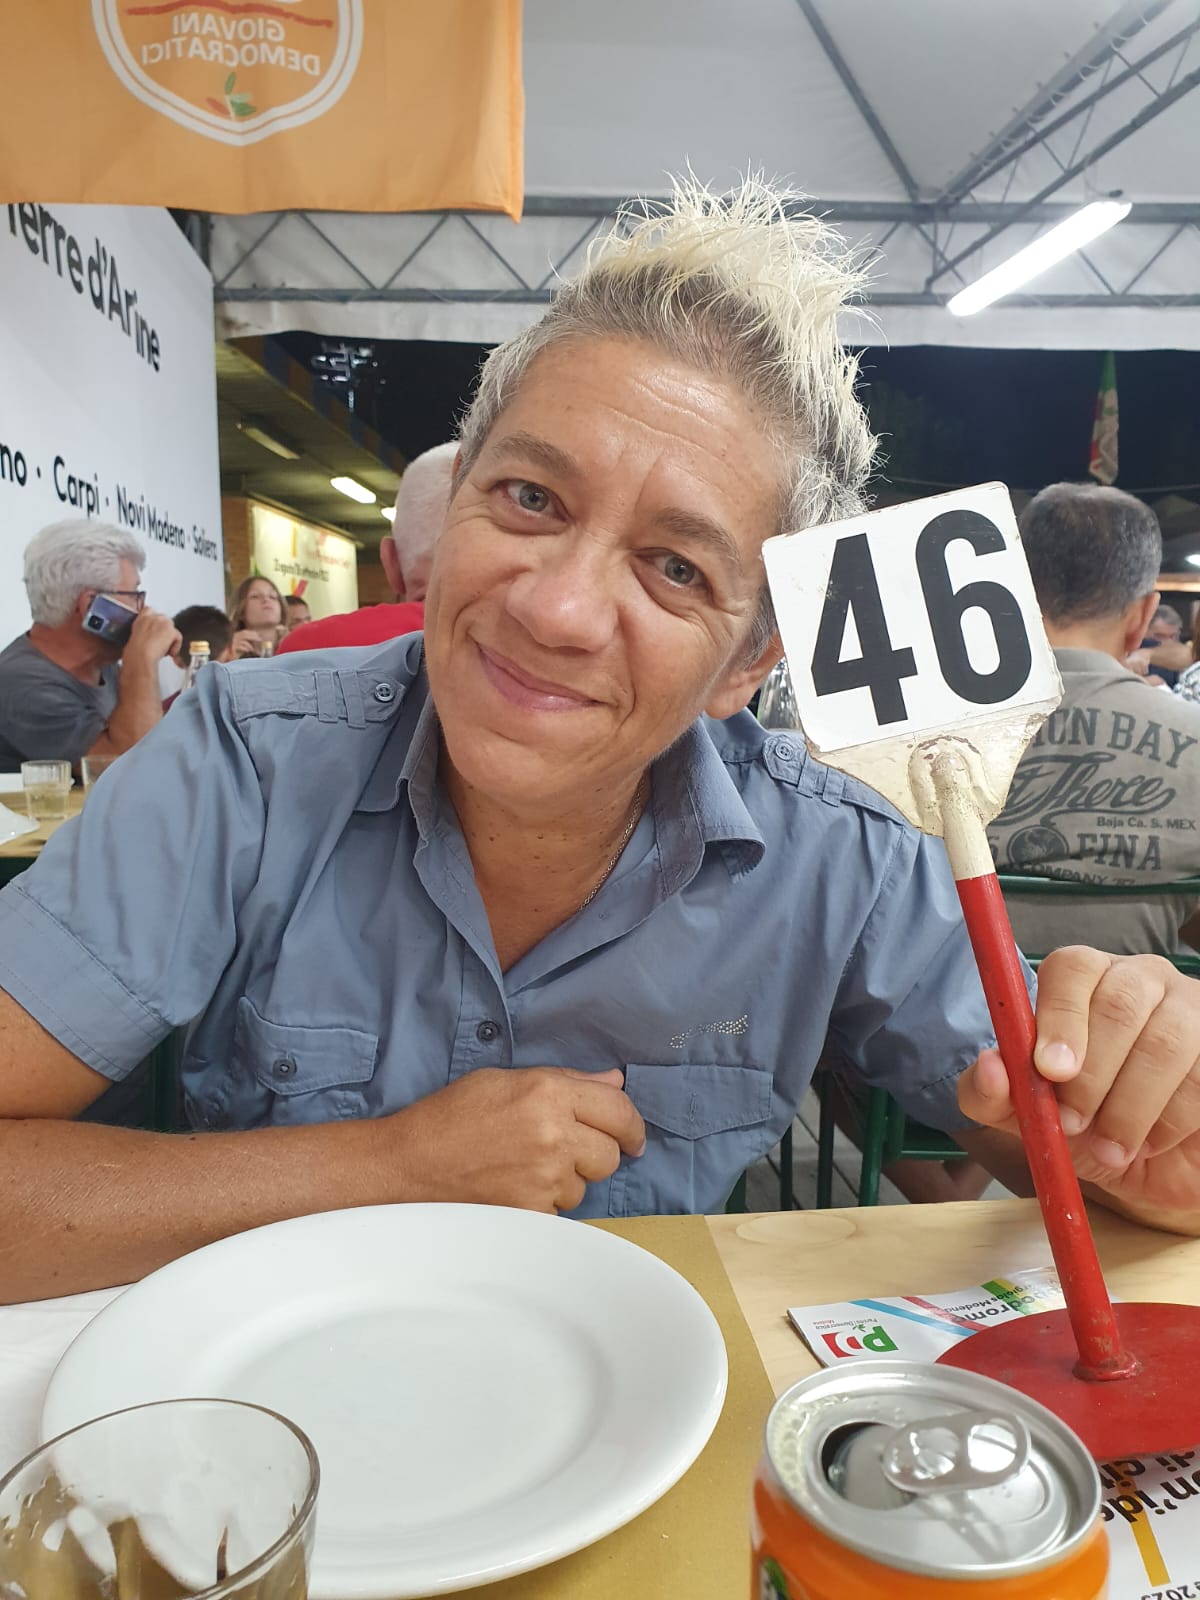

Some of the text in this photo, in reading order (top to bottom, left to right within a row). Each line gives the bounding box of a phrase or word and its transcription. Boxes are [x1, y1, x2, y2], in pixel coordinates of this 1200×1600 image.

[54, 456, 99, 517] Carpi
[116, 484, 146, 531] Novi
[811, 509, 1032, 726] 46
[1107, 710, 1198, 769] BAY
[1096, 816, 1124, 829] Baja
[1166, 818, 1197, 831] MEX
